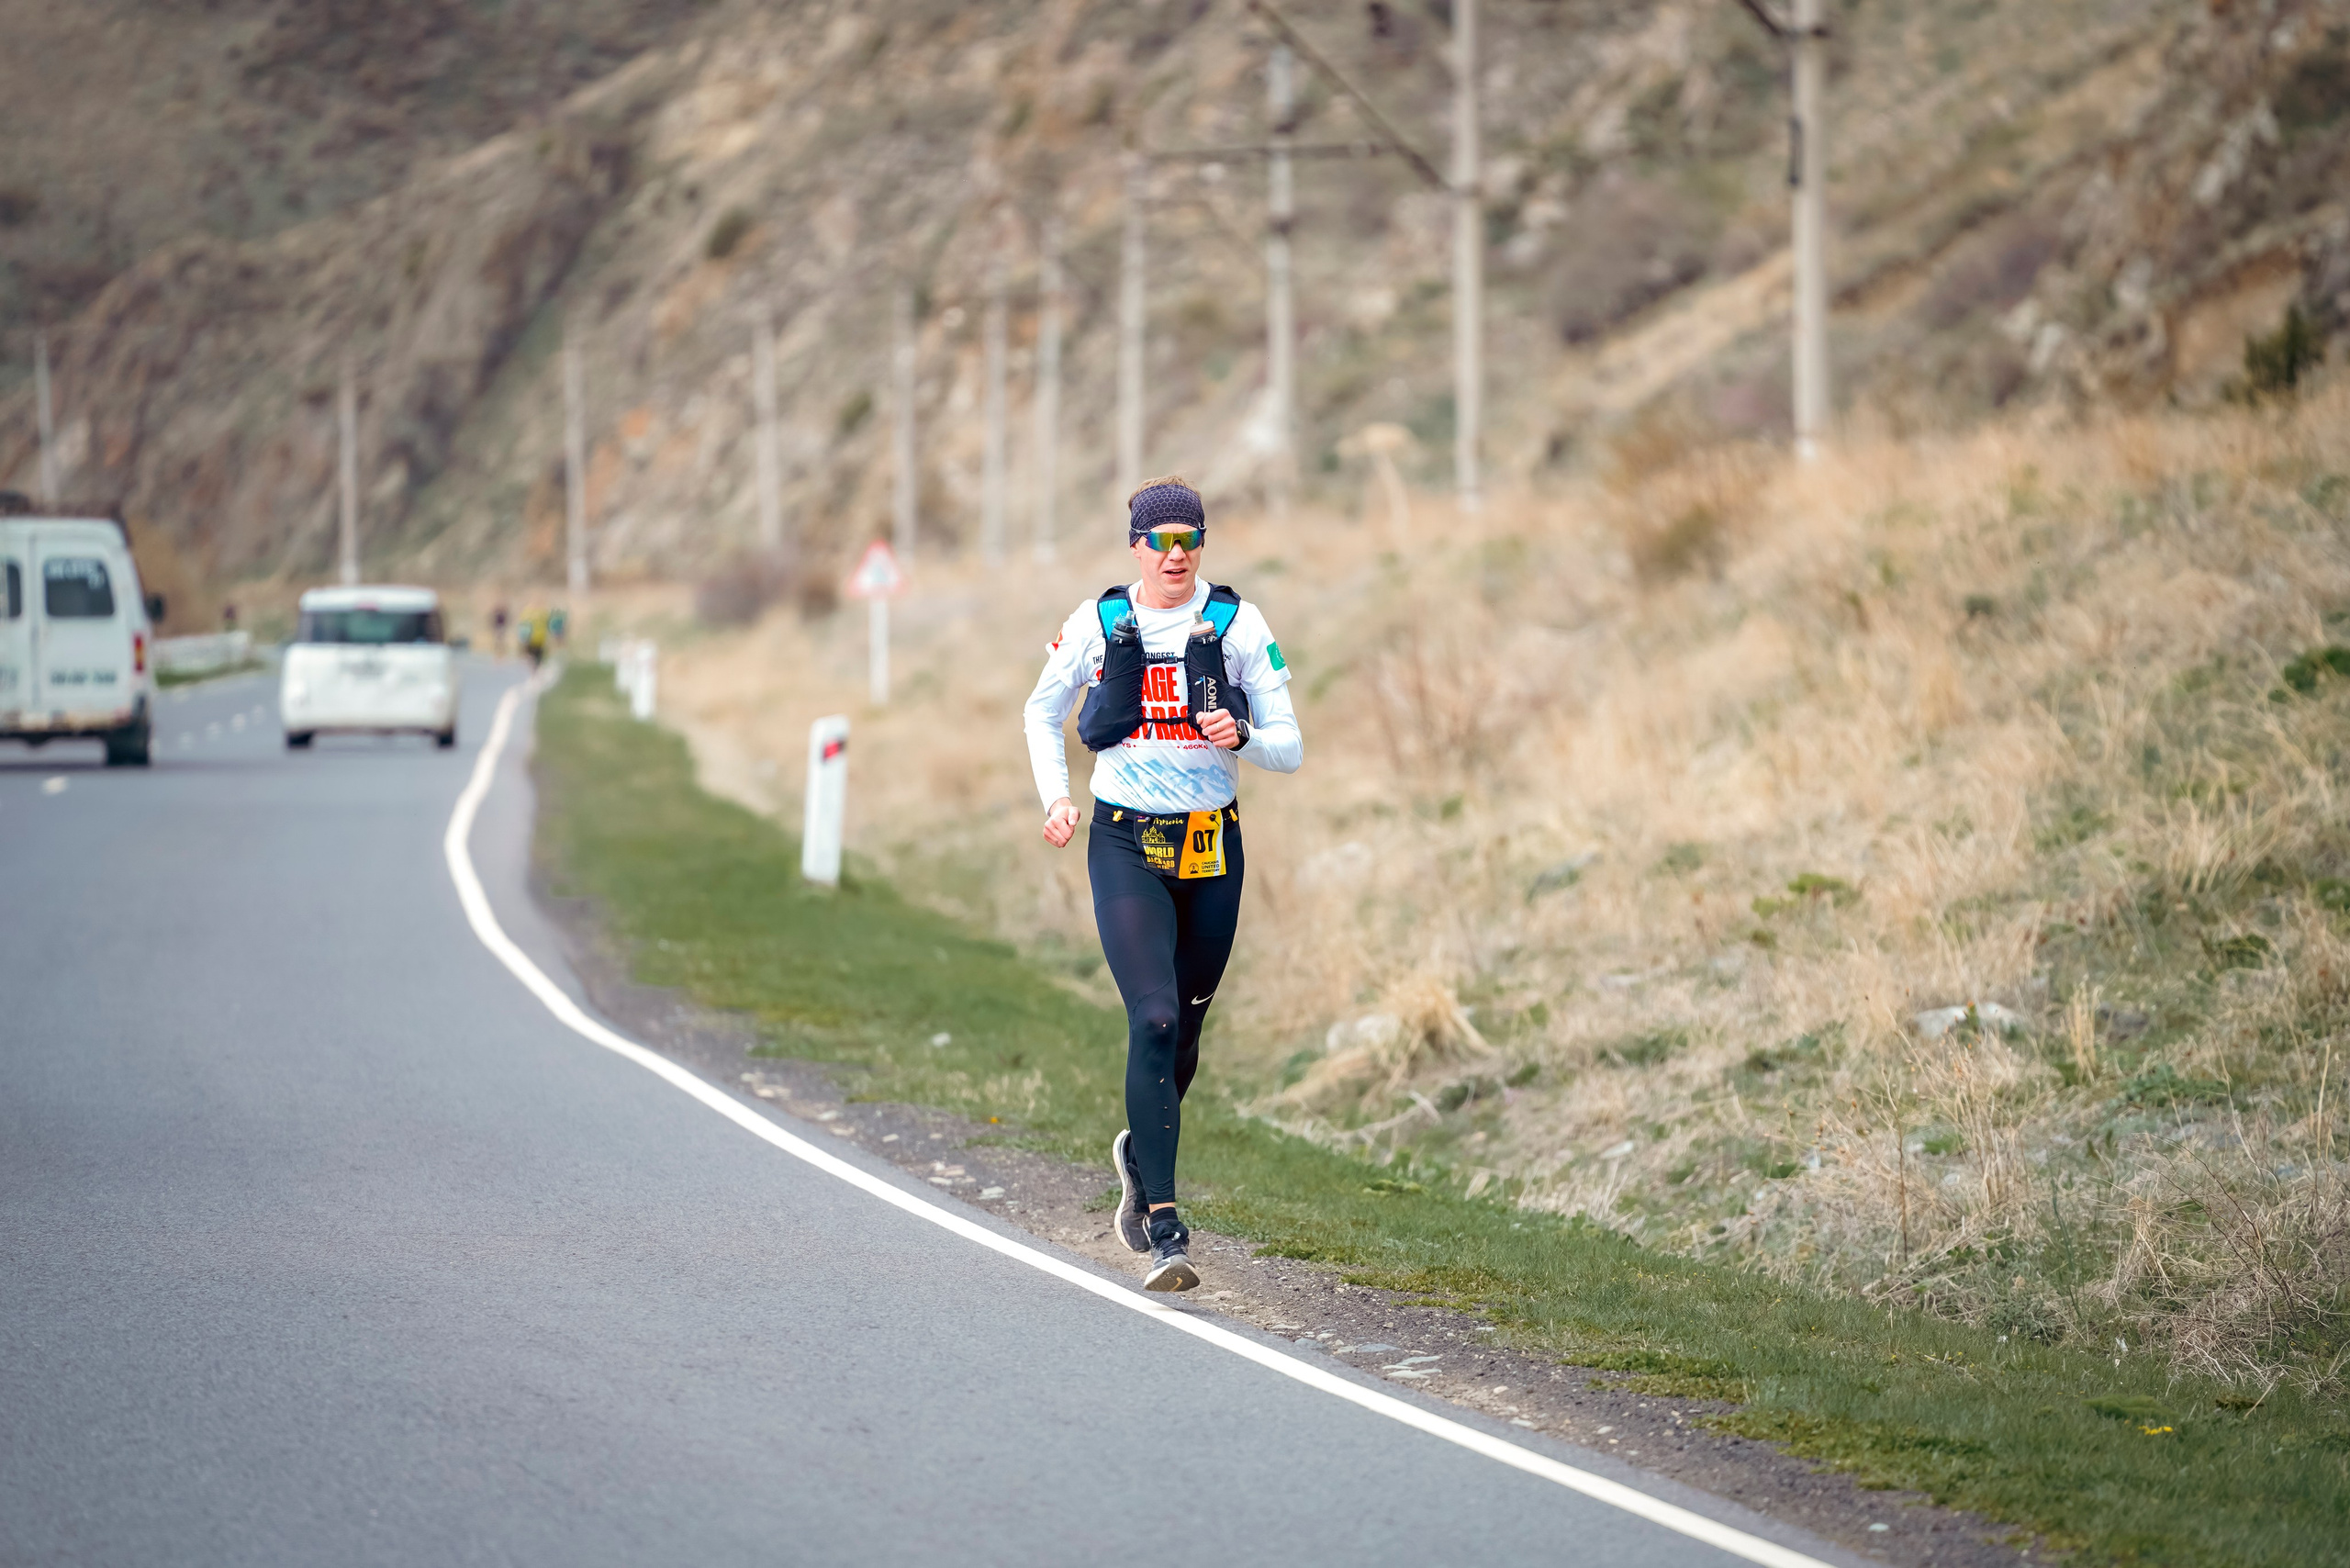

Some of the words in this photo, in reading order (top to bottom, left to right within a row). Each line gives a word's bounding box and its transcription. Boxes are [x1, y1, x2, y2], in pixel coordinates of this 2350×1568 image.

[1092, 655, 1103, 665] THE
[1141, 666, 1180, 702] AGE
[1207, 677, 1217, 712] AONI
[1143, 845, 1175, 858] WORLD
[1192, 829, 1215, 853] 07
